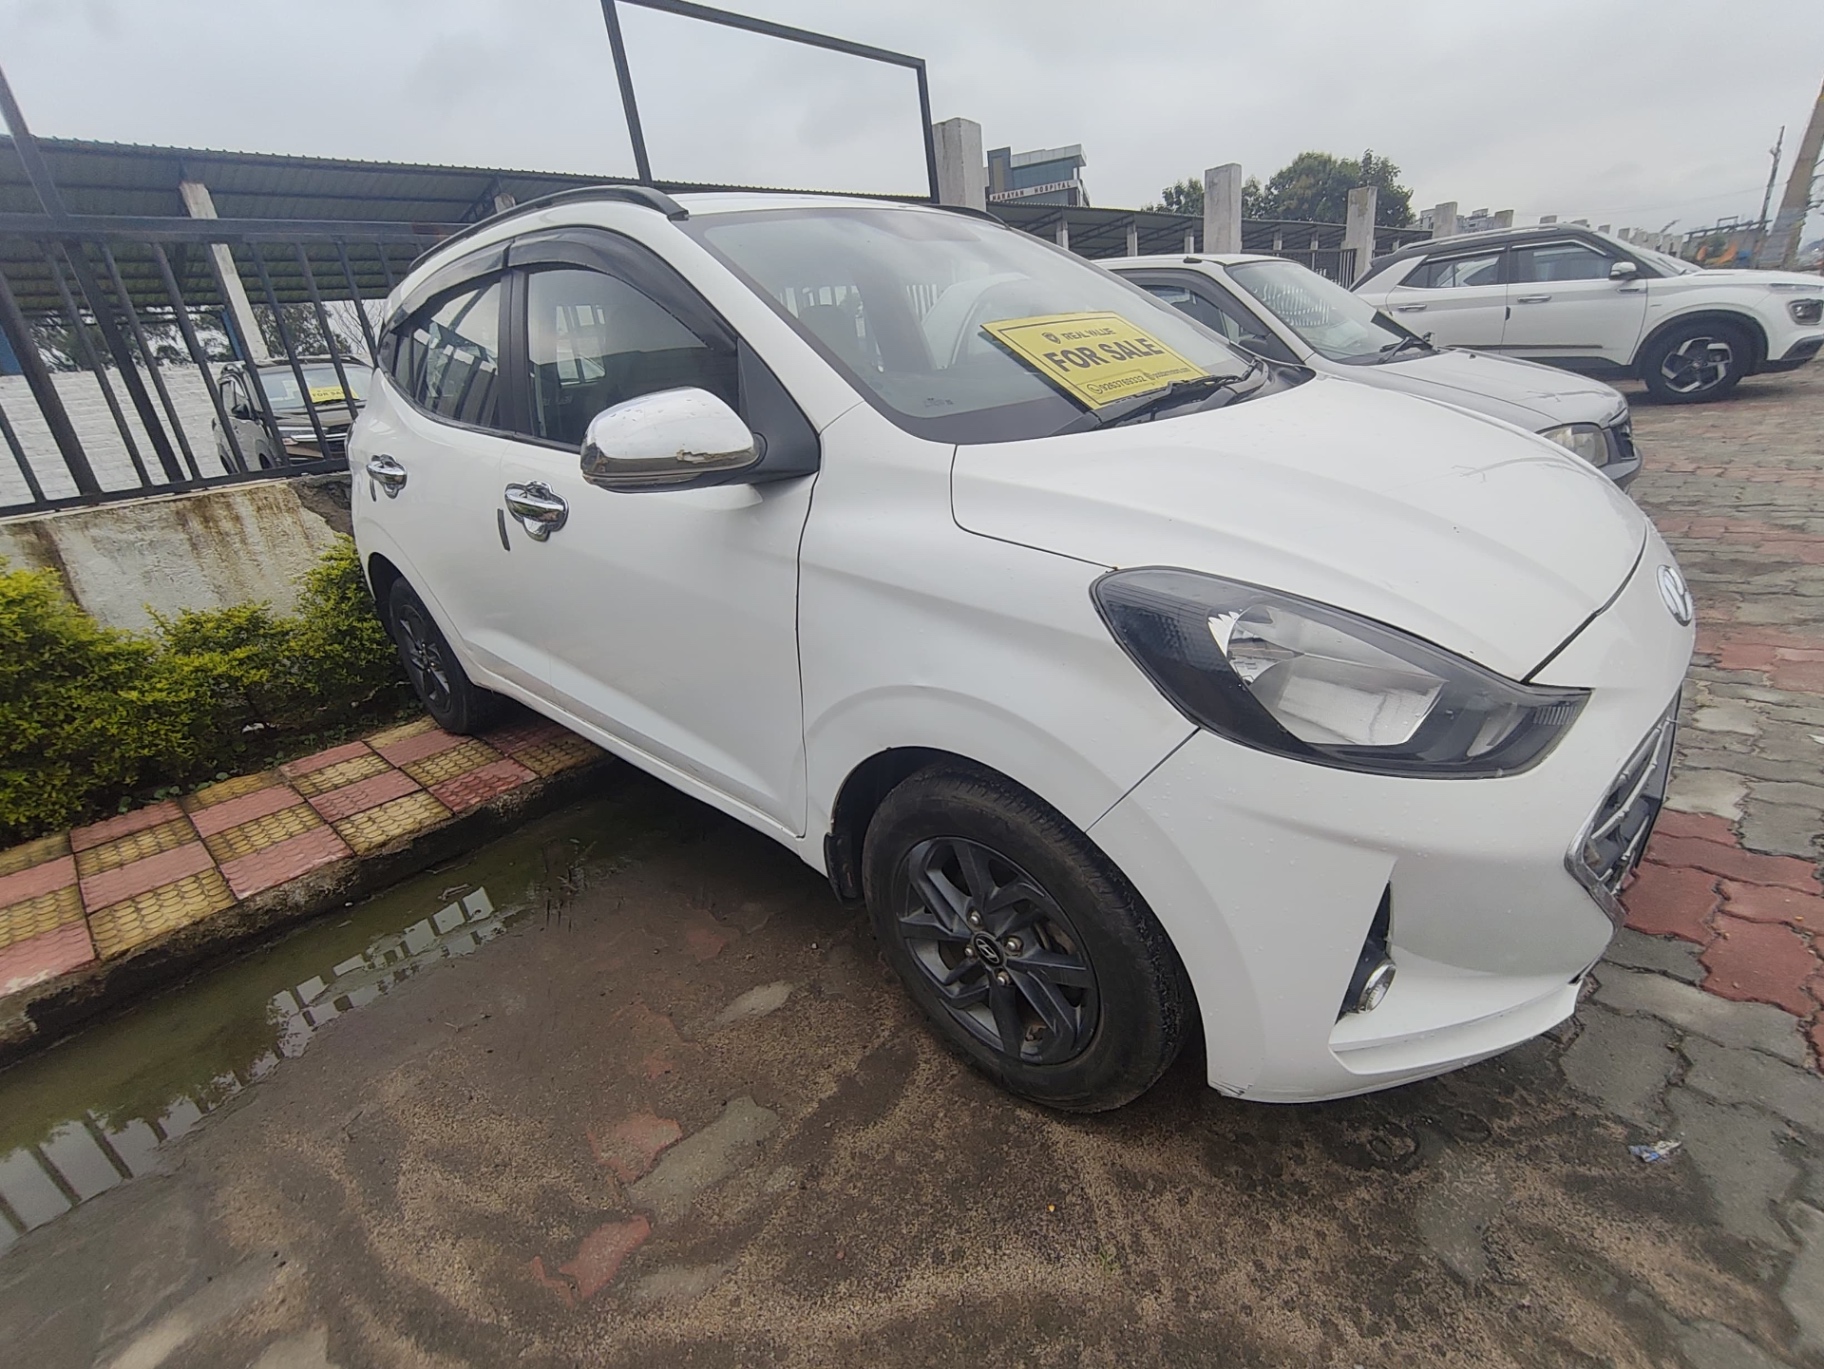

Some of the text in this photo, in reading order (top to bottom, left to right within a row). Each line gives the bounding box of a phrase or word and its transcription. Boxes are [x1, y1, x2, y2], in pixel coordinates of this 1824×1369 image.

[992, 182, 1071, 201] NARAYAN HOSPITAL
[1061, 328, 1116, 340] REAL VALUE
[1043, 338, 1164, 372] FOR SALE
